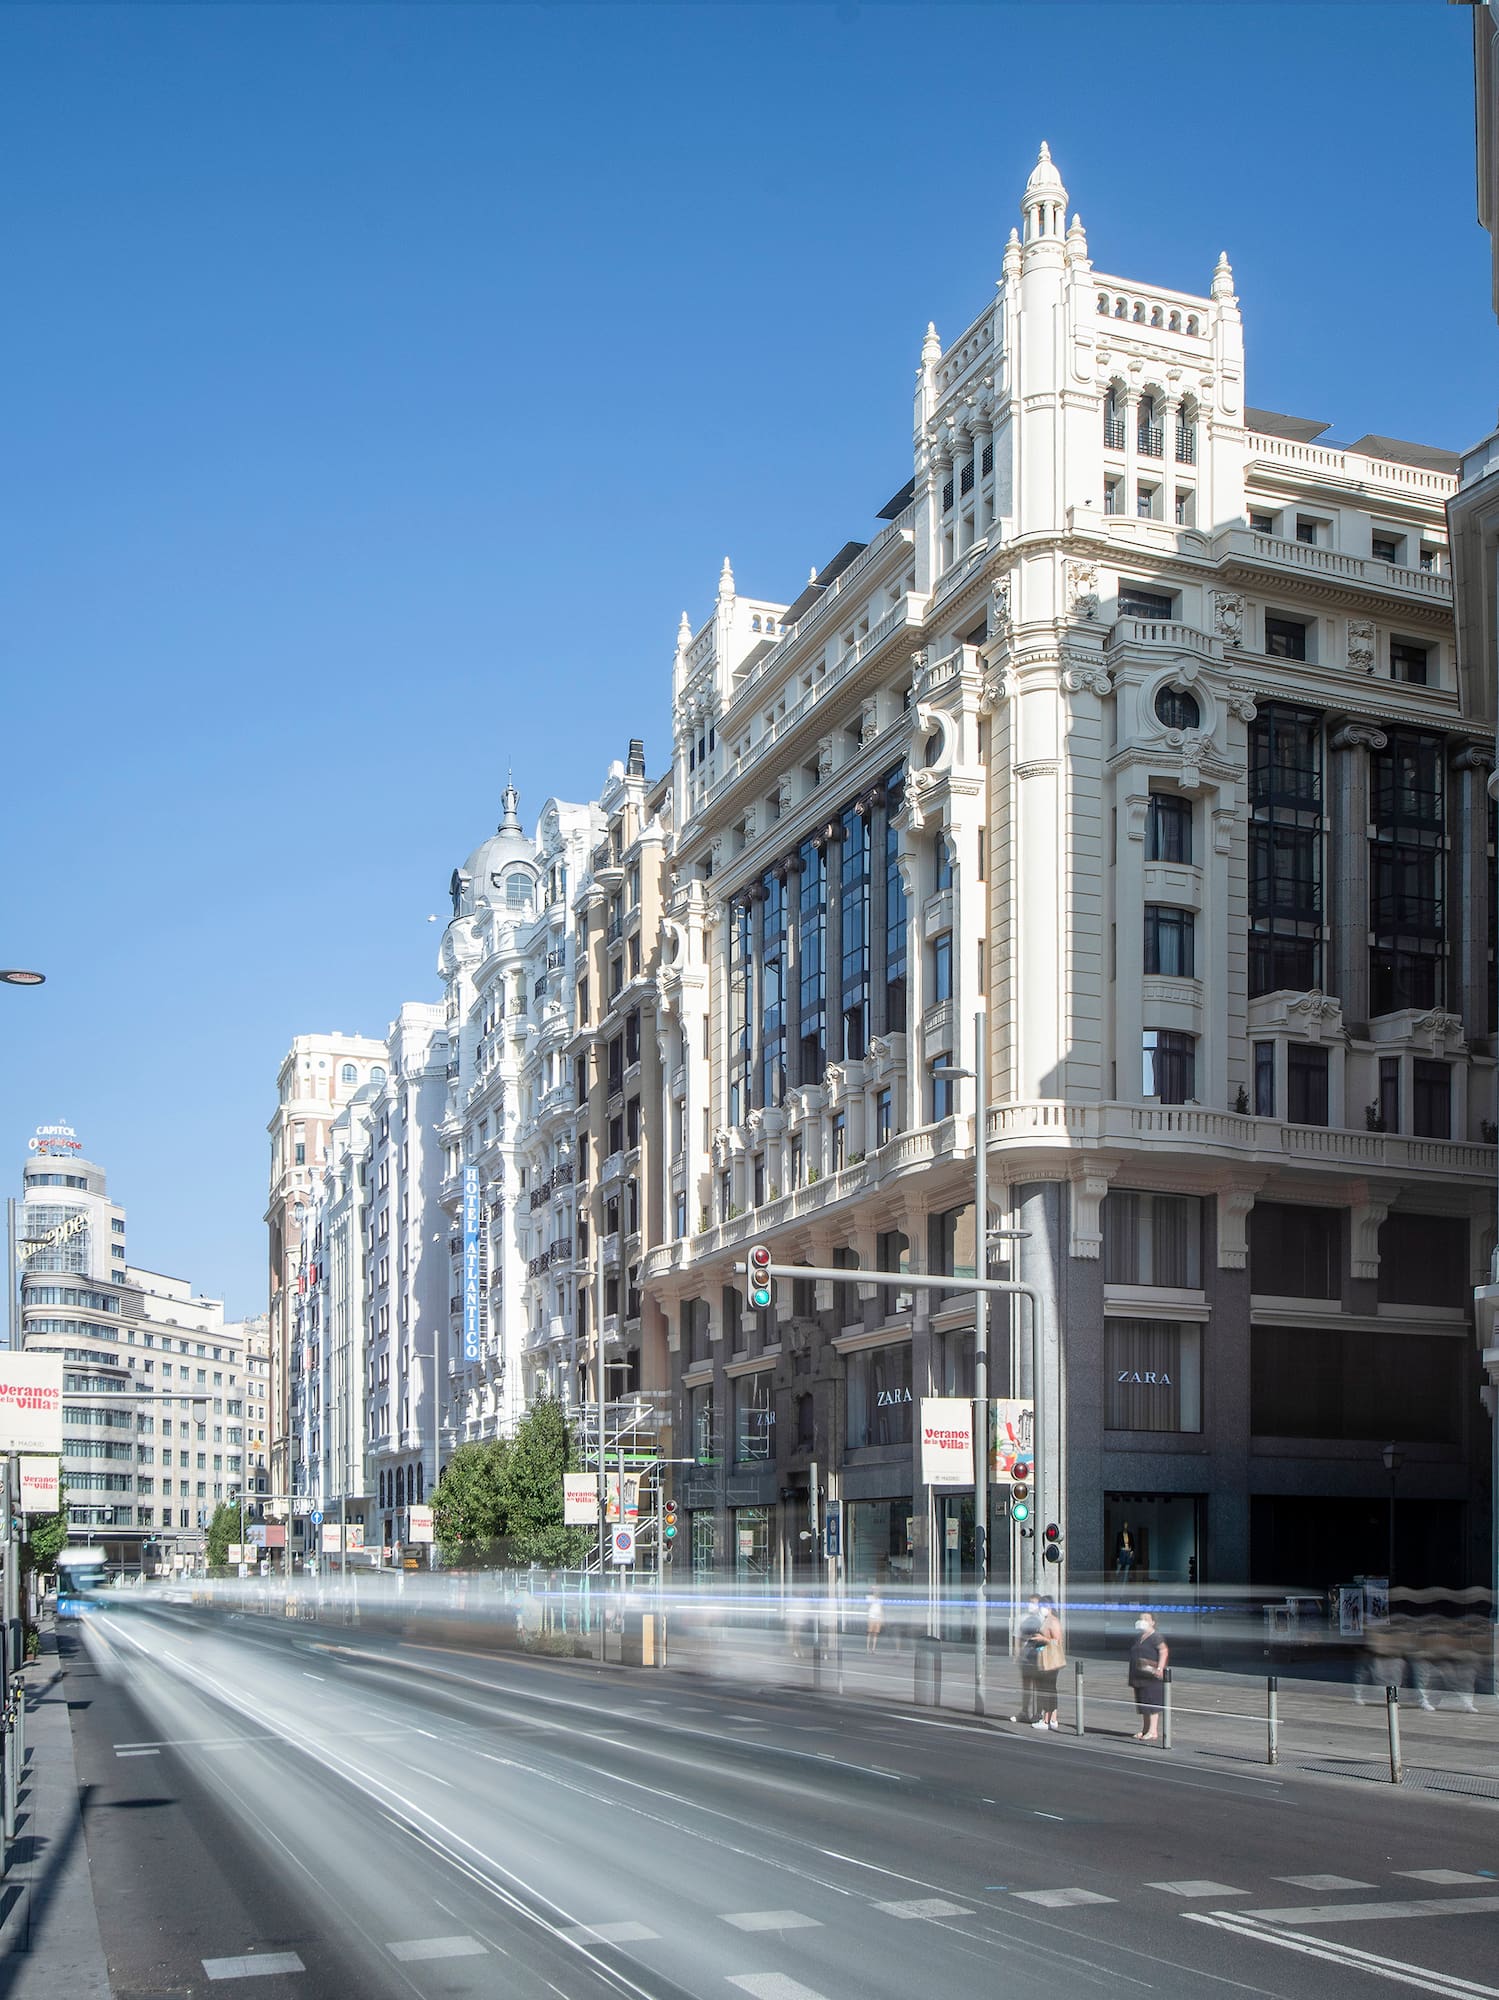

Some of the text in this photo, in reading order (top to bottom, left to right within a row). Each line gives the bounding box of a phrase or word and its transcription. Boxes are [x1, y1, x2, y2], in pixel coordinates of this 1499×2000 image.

[37, 1126, 76, 1137] CAPITOL
[466, 1168, 477, 1358] HOTEL ATLANTICO
[1118, 1370, 1172, 1386] ZARA
[16, 1397, 51, 1410] Villa
[877, 1387, 913, 1407] ZARA
[757, 1411, 776, 1426] ZAR
[925, 1428, 969, 1439] Veranos
[939, 1440, 964, 1449] Villa
